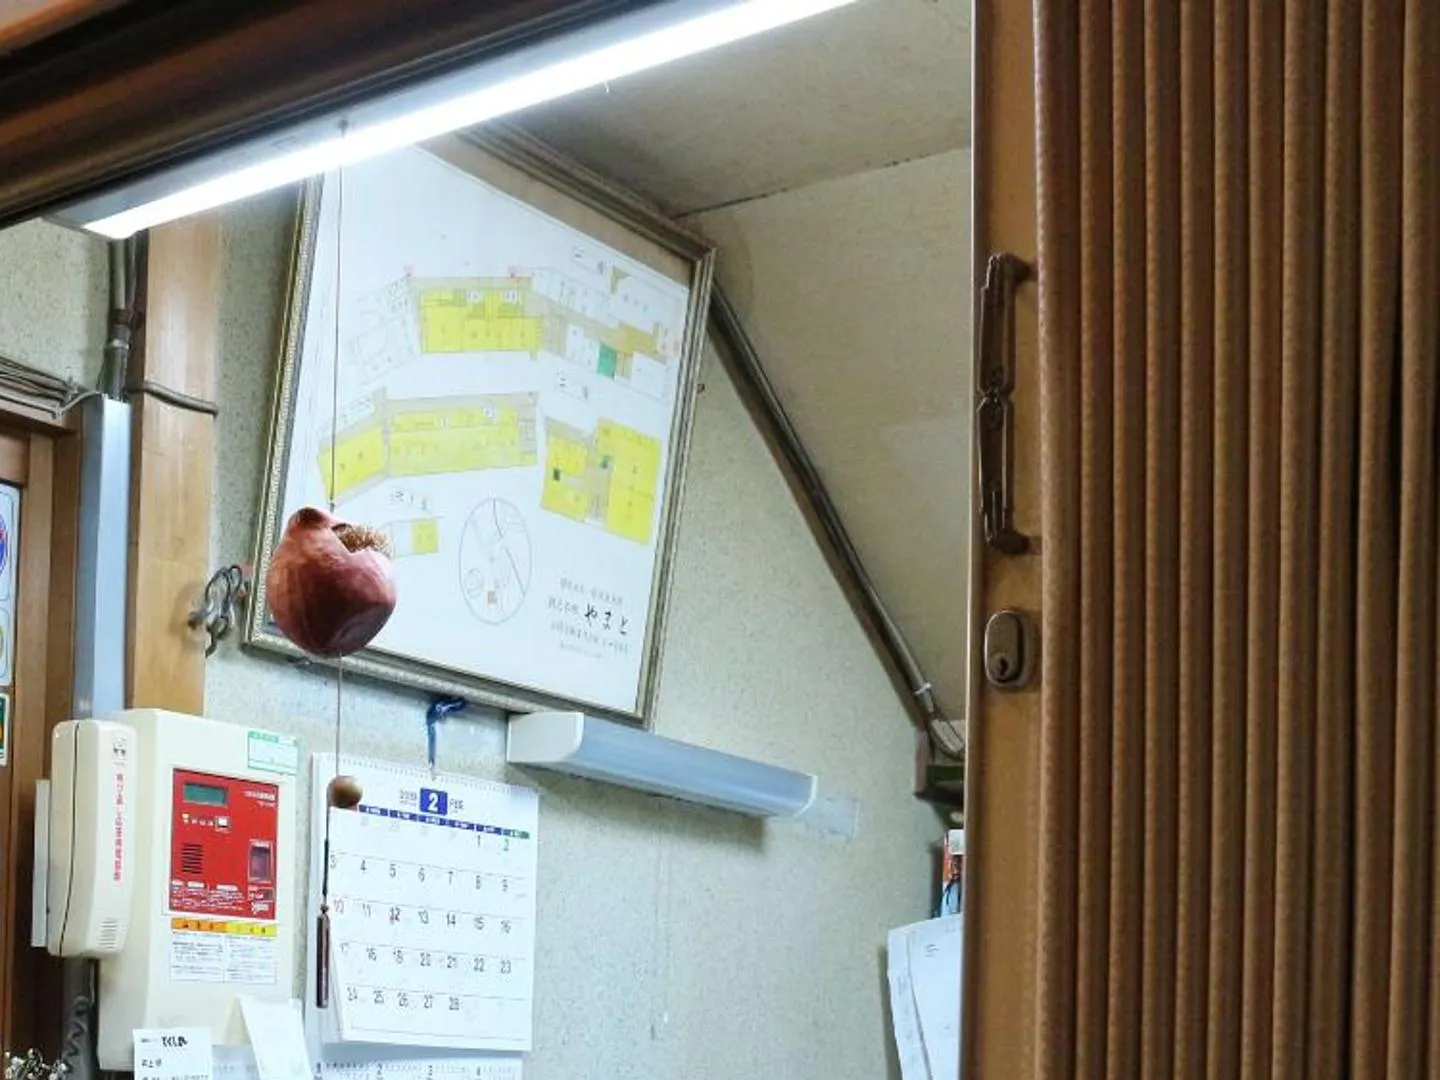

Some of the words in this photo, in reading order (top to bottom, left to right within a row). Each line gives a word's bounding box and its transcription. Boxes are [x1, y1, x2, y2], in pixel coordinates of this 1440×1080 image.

[427, 792, 439, 812] 2
[362, 904, 372, 919] 11
[390, 907, 402, 922] 12
[419, 910, 430, 926] 13
[446, 913, 457, 928] 14
[474, 916, 486, 931] 15
[500, 920, 512, 934] 16
[366, 947, 378, 962] 18
[393, 950, 404, 965] 19
[420, 952, 432, 968] 20
[473, 957, 485, 973] 22
[500, 960, 512, 975] 23
[373, 990, 385, 1005] 25
[398, 993, 410, 1008] 26
[449, 997, 460, 1012] 28
